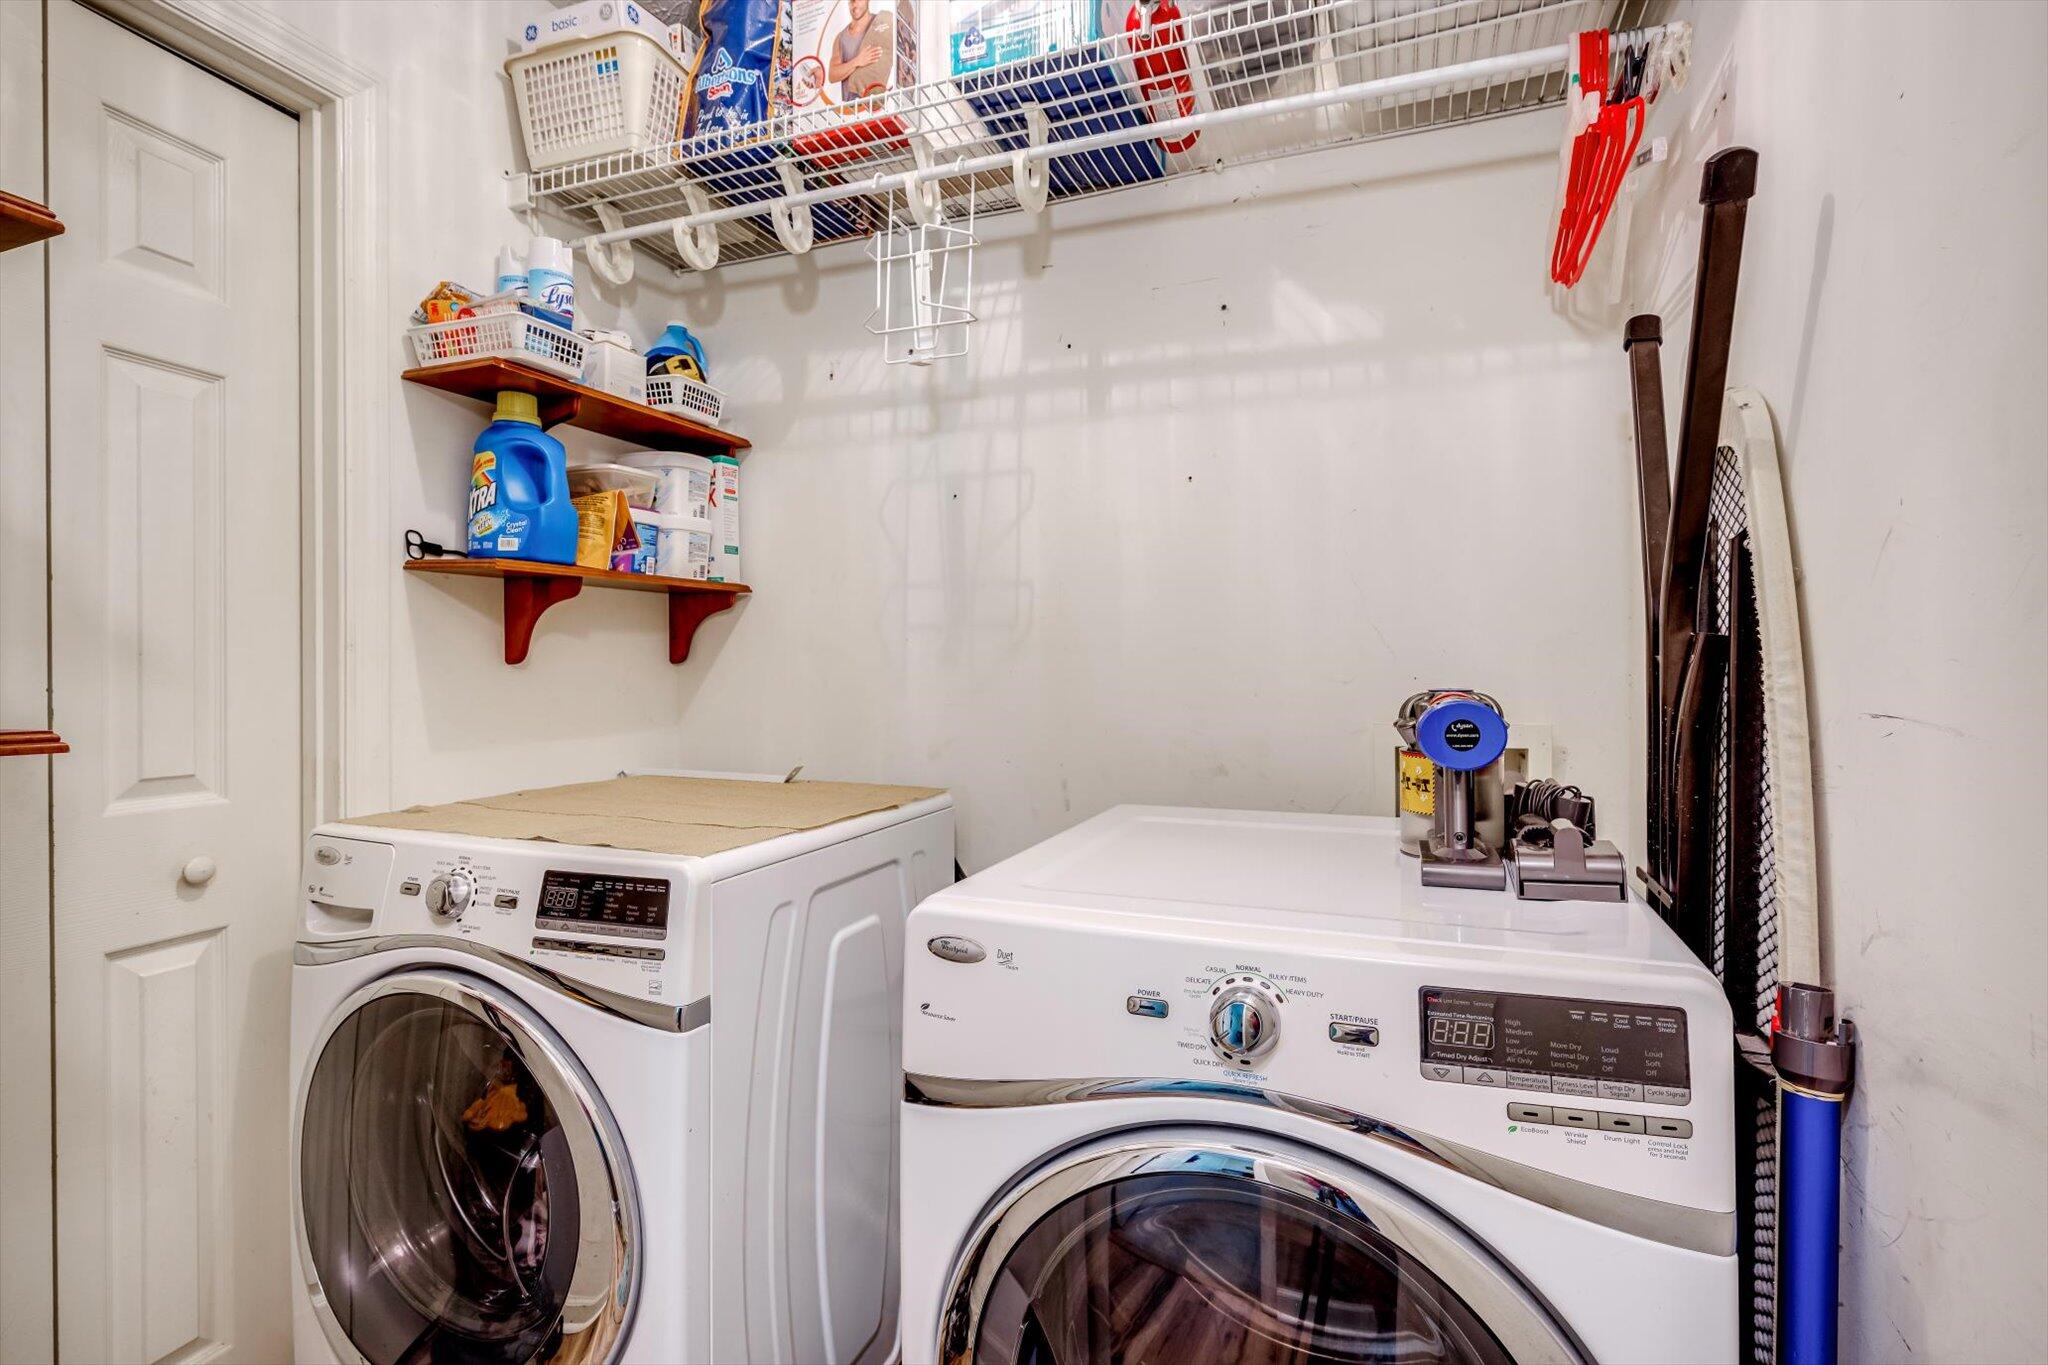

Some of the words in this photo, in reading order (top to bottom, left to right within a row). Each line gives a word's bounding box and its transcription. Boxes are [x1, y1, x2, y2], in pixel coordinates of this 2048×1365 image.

[551, 15, 578, 32] basic
[541, 285, 574, 310] Lyso
[506, 519, 528, 528] Crystal
[506, 525, 523, 534] Clean
[997, 948, 1013, 961] Duet
[1205, 965, 1227, 974] CASUAL
[1235, 964, 1262, 973] NORMAL
[1185, 976, 1211, 985] DELICATE
[1268, 973, 1287, 981] BULKY
[1288, 975, 1307, 984] ITEMS
[1137, 988, 1161, 997] POWER
[1285, 989, 1305, 997] HEAVY
[1306, 991, 1324, 999] DUTY
[1330, 1013, 1379, 1025] START/PAUSE
[1427, 1010, 1452, 1018] Estimated
[1466, 1013, 1494, 1022] Remaining
[1591, 1015, 1608, 1023] Damp
[1505, 1018, 1521, 1026] High
[1655, 1021, 1678, 1029] Wrinkle
[1506, 1027, 1533, 1036] Medium
[1550, 1041, 1568, 1049] More
[1569, 1042, 1582, 1051] Dry
[1601, 1046, 1619, 1054] Loud
[1506, 1047, 1523, 1056] Extra
[1645, 1050, 1663, 1058] Loud
[1437, 1051, 1456, 1059] Timed
[1456, 1053, 1467, 1061] Dry
[1468, 1054, 1488, 1062] Adjust
[1550, 1051, 1576, 1060] Normal
[1577, 1053, 1590, 1062] Dry
[1193, 1058, 1211, 1066] QUICK
[1519, 1057, 1533, 1066] Only
[1566, 1062, 1579, 1071] Dry
[1223, 1070, 1241, 1078] QUICK
[1645, 1069, 1658, 1077] Off
[1509, 1074, 1548, 1084] Temperature
[1553, 1080, 1579, 1089] Dryness
[1580, 1082, 1597, 1090] Level
[1602, 1084, 1624, 1093] Damp
[1623, 1086, 1636, 1095] Dry
[1610, 1091, 1630, 1099] Signal
[1647, 1089, 1664, 1097] Cycle
[1665, 1090, 1687, 1100] Signal
[1520, 1126, 1549, 1135] EcoBoost
[1565, 1131, 1589, 1139] Wrinkle
[1567, 1138, 1587, 1146] Shield
[1624, 1136, 1641, 1145] Light
[1647, 1140, 1672, 1148] Control
